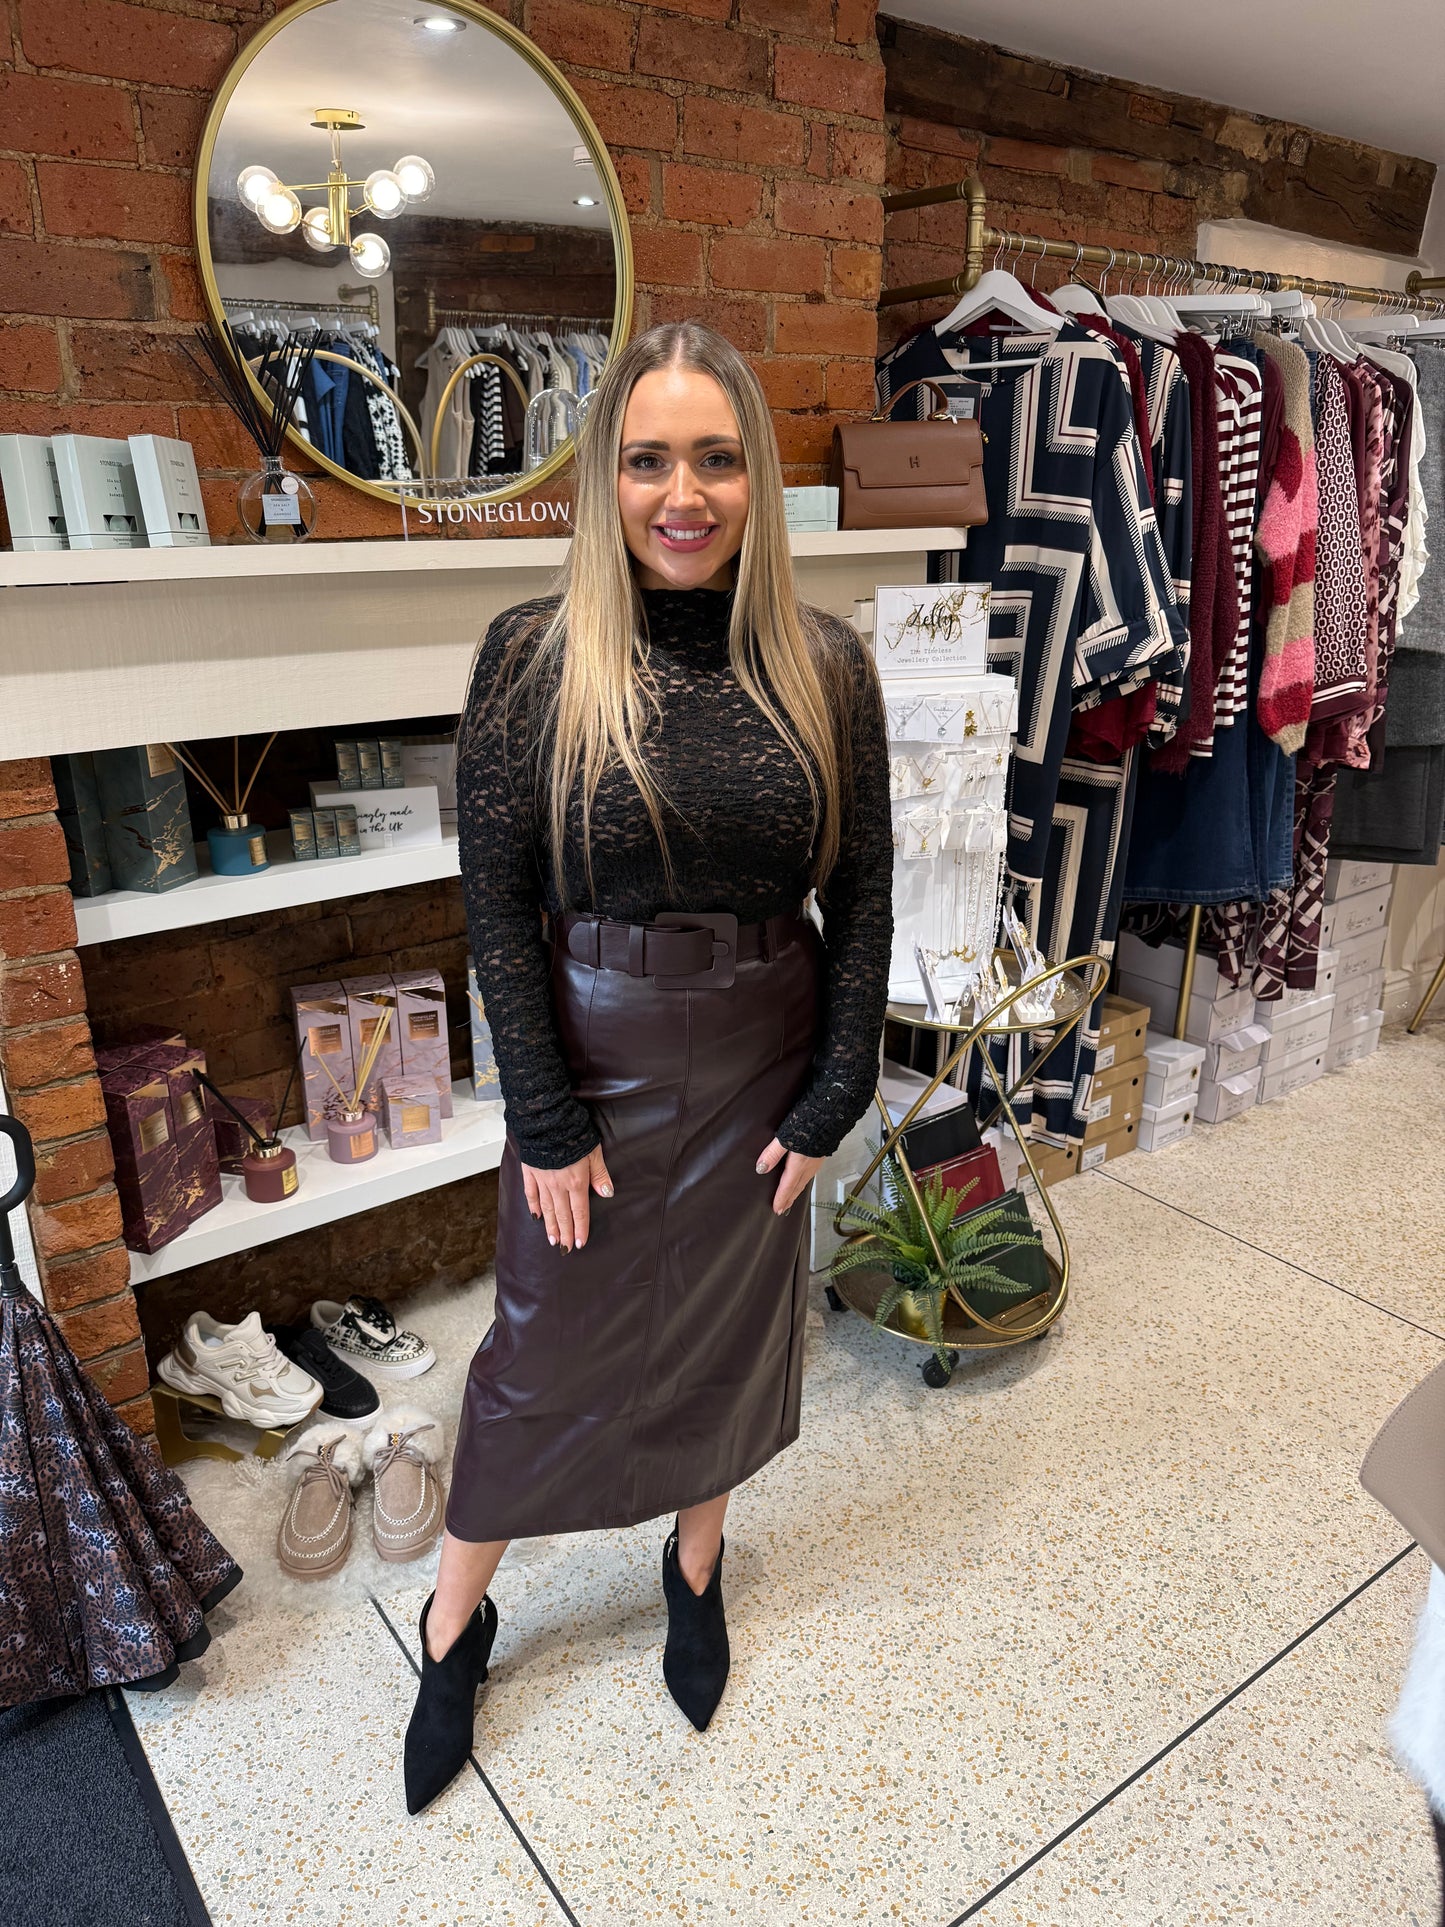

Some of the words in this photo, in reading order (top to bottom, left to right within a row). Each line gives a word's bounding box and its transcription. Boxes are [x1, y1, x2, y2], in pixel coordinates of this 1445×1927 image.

[417, 501, 570, 524] STONEGLOW
[907, 601, 953, 642] Zelly
[897, 656, 930, 664] Jewellery
[931, 655, 967, 663] Collection
[389, 804, 414, 817] made
[369, 822, 386, 833] the
[389, 821, 404, 832] UK
